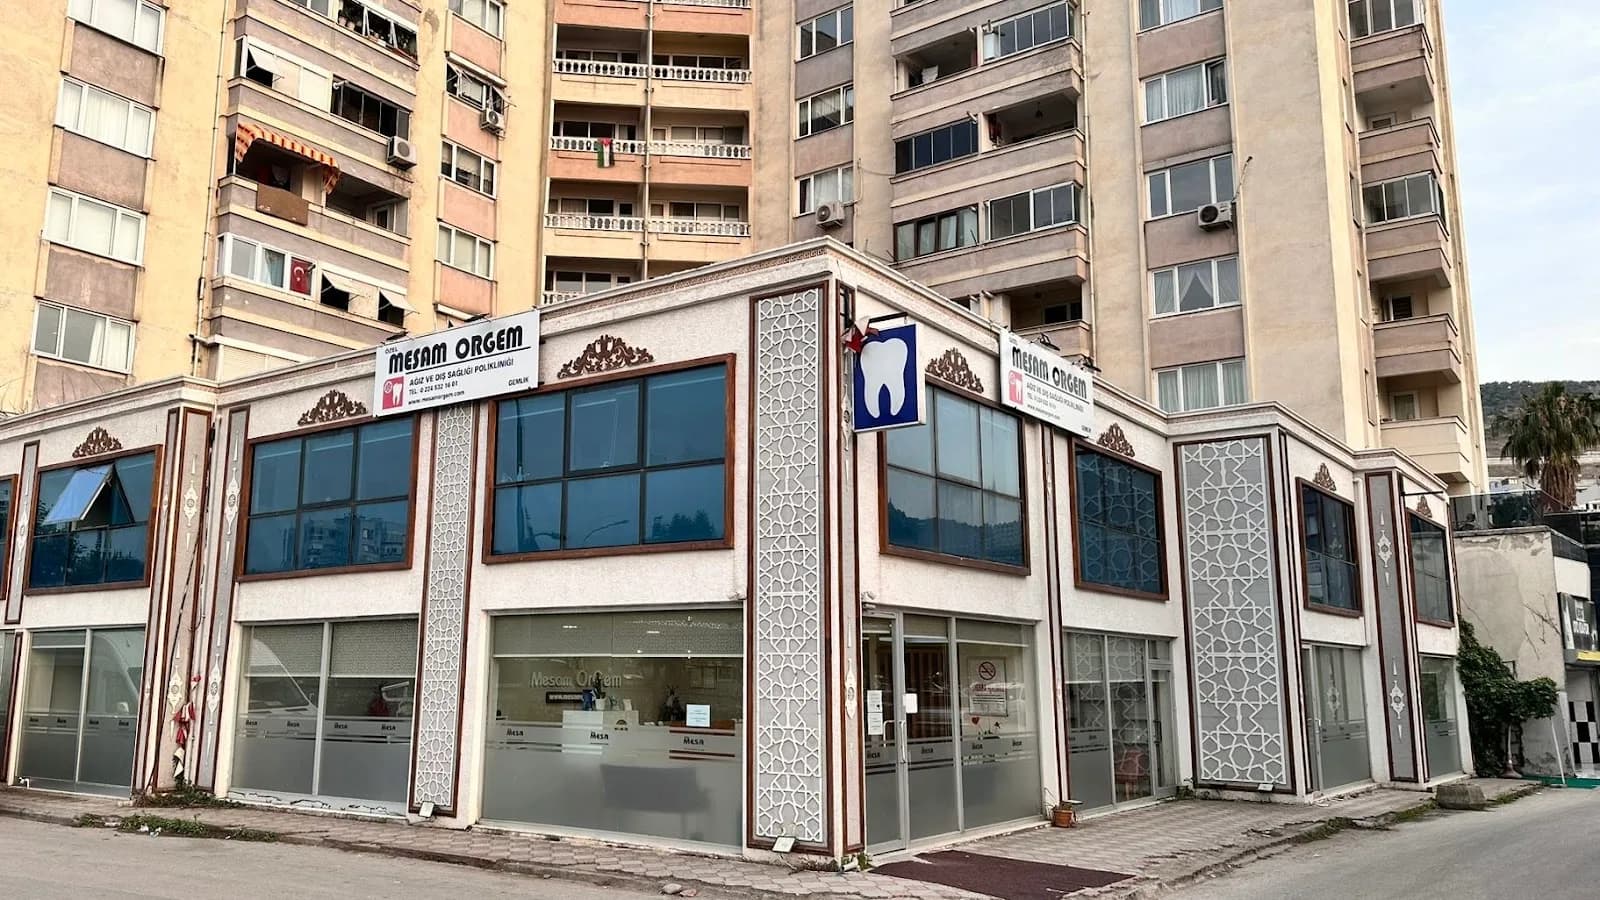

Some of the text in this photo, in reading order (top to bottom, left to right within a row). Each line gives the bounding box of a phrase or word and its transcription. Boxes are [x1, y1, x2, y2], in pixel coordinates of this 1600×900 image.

[388, 325, 523, 374] MESAM ORGEM
[1012, 346, 1087, 399] MESAM ORGEM
[426, 374, 434, 383] VE
